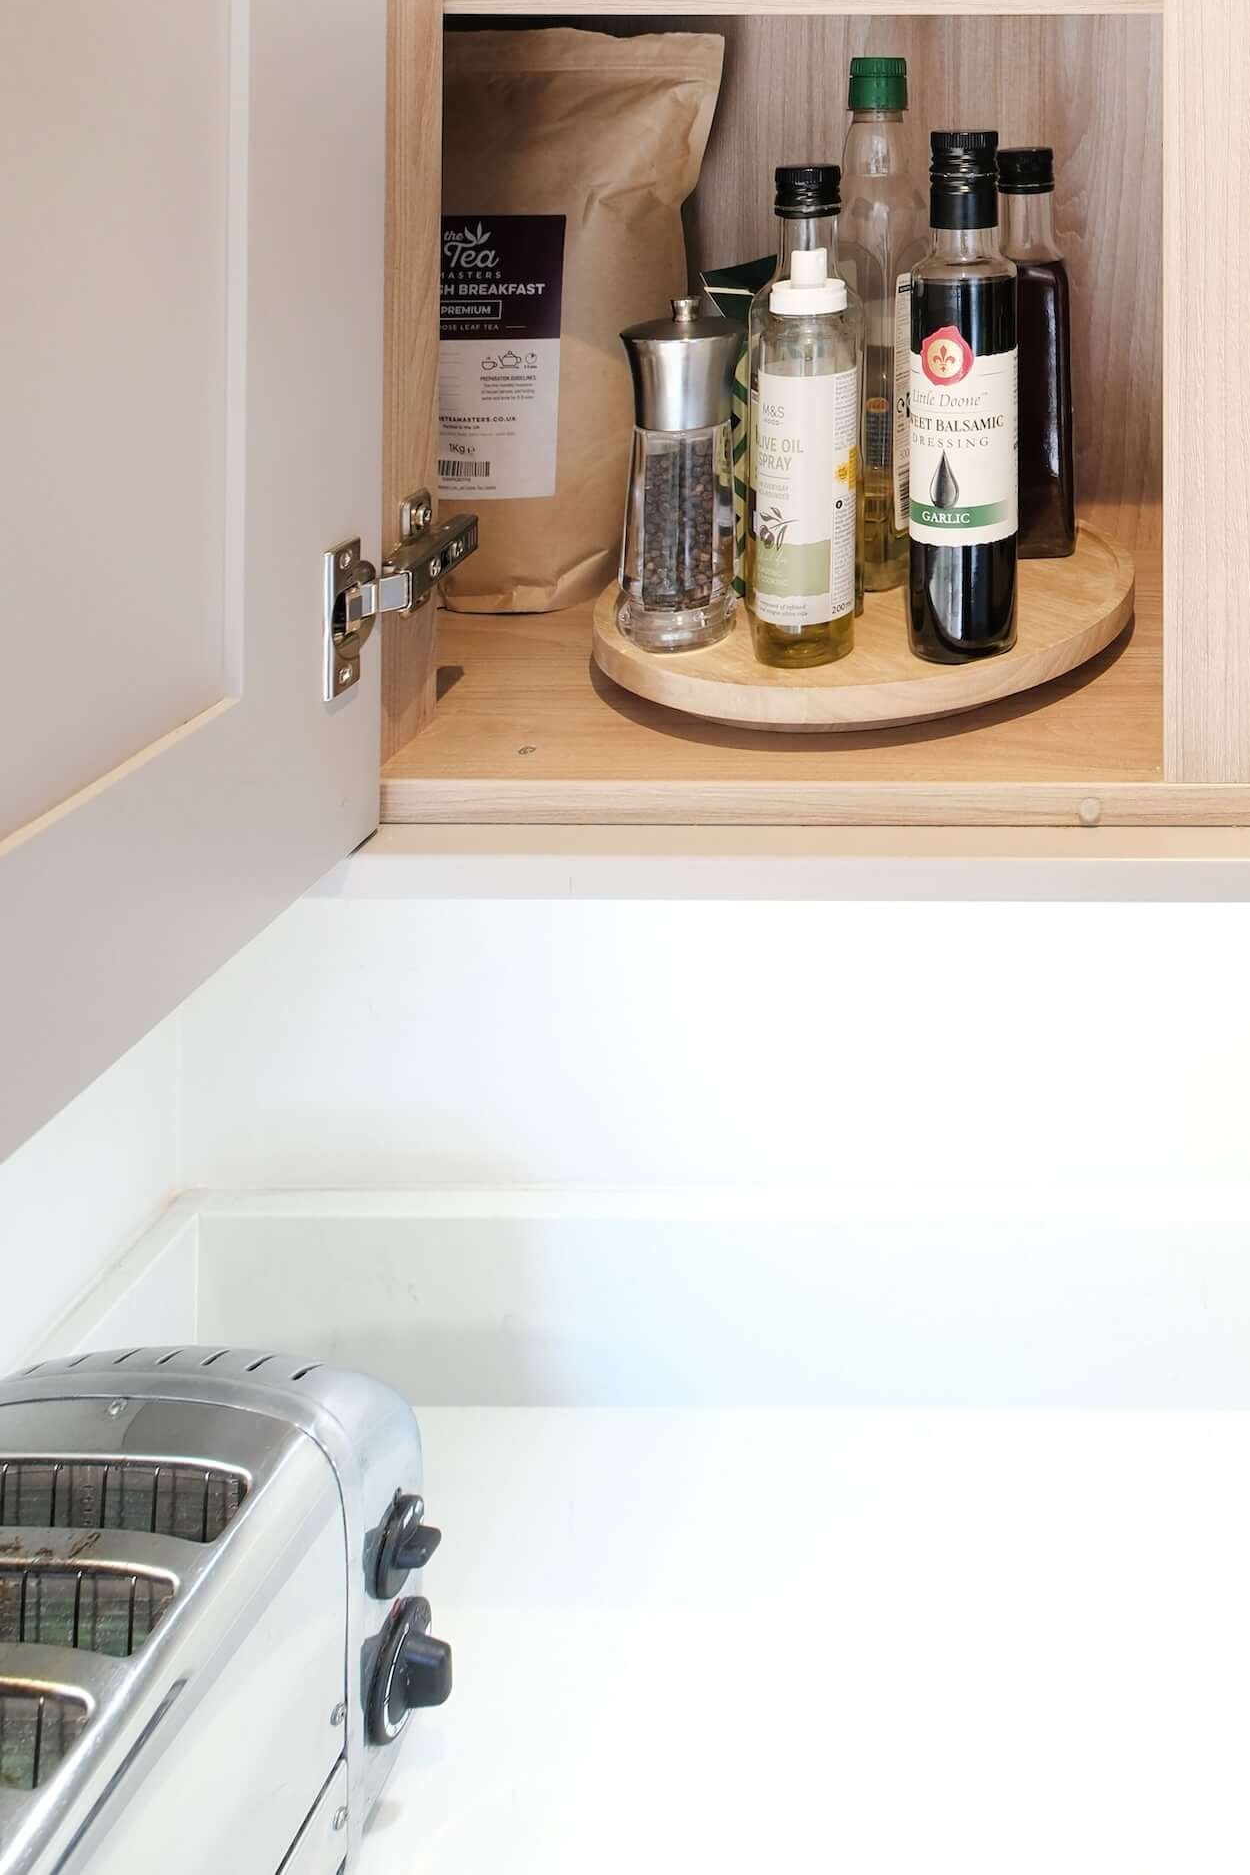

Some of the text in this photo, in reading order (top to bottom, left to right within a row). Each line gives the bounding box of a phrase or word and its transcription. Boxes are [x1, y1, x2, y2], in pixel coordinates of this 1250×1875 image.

[444, 230, 464, 242] the
[444, 241, 500, 268] Tea
[458, 283, 546, 296] BREAKFAST
[441, 306, 492, 315] PREMIUM
[912, 389, 981, 408] Little Doone
[762, 404, 785, 419] M&S
[936, 415, 1004, 433] BALSAMIC
[448, 442, 466, 455] 1Kg
[759, 436, 804, 454] LIVE OIL
[912, 433, 989, 449] DRESSING
[921, 510, 971, 524] GARLIC
